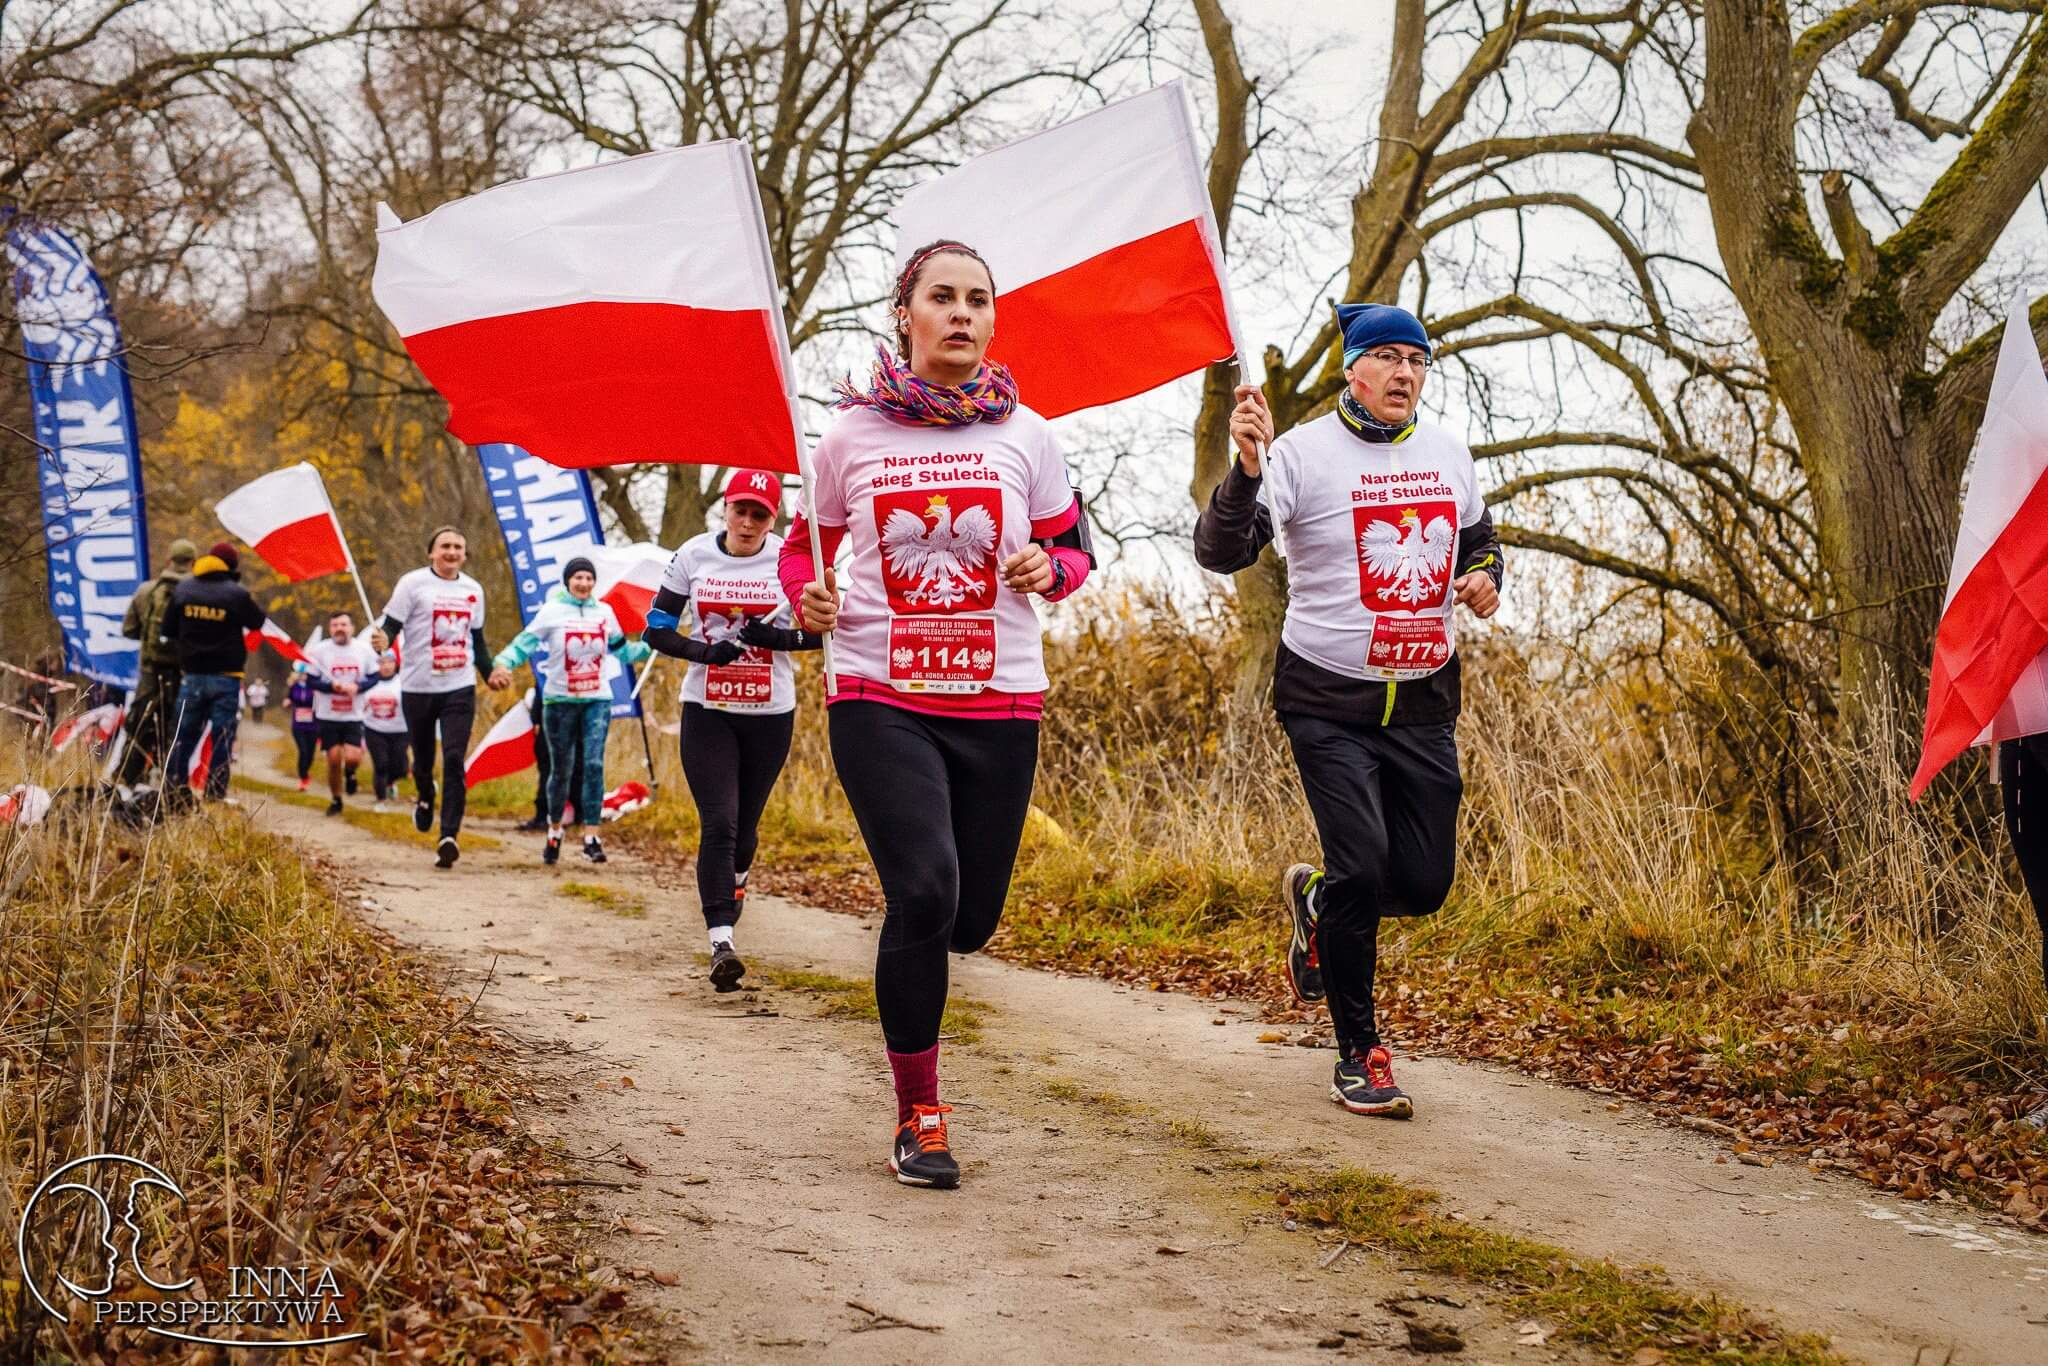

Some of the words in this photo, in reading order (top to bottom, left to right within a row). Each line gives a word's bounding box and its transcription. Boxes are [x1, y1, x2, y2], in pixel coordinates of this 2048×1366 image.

[883, 452, 984, 469] Narodowy
[750, 473, 768, 491] NY
[872, 472, 913, 488] Bieg
[918, 467, 1000, 483] Stulecia
[1360, 470, 1440, 485] Narodowy
[1351, 489, 1388, 502] Bieg
[1391, 483, 1453, 499] Stulecia
[706, 577, 769, 590] Narodowy
[697, 588, 721, 600] Bieg
[726, 590, 777, 600] Stulecia
[917, 646, 970, 668] 114
[1392, 641, 1434, 661] 177
[721, 681, 756, 697] 015
